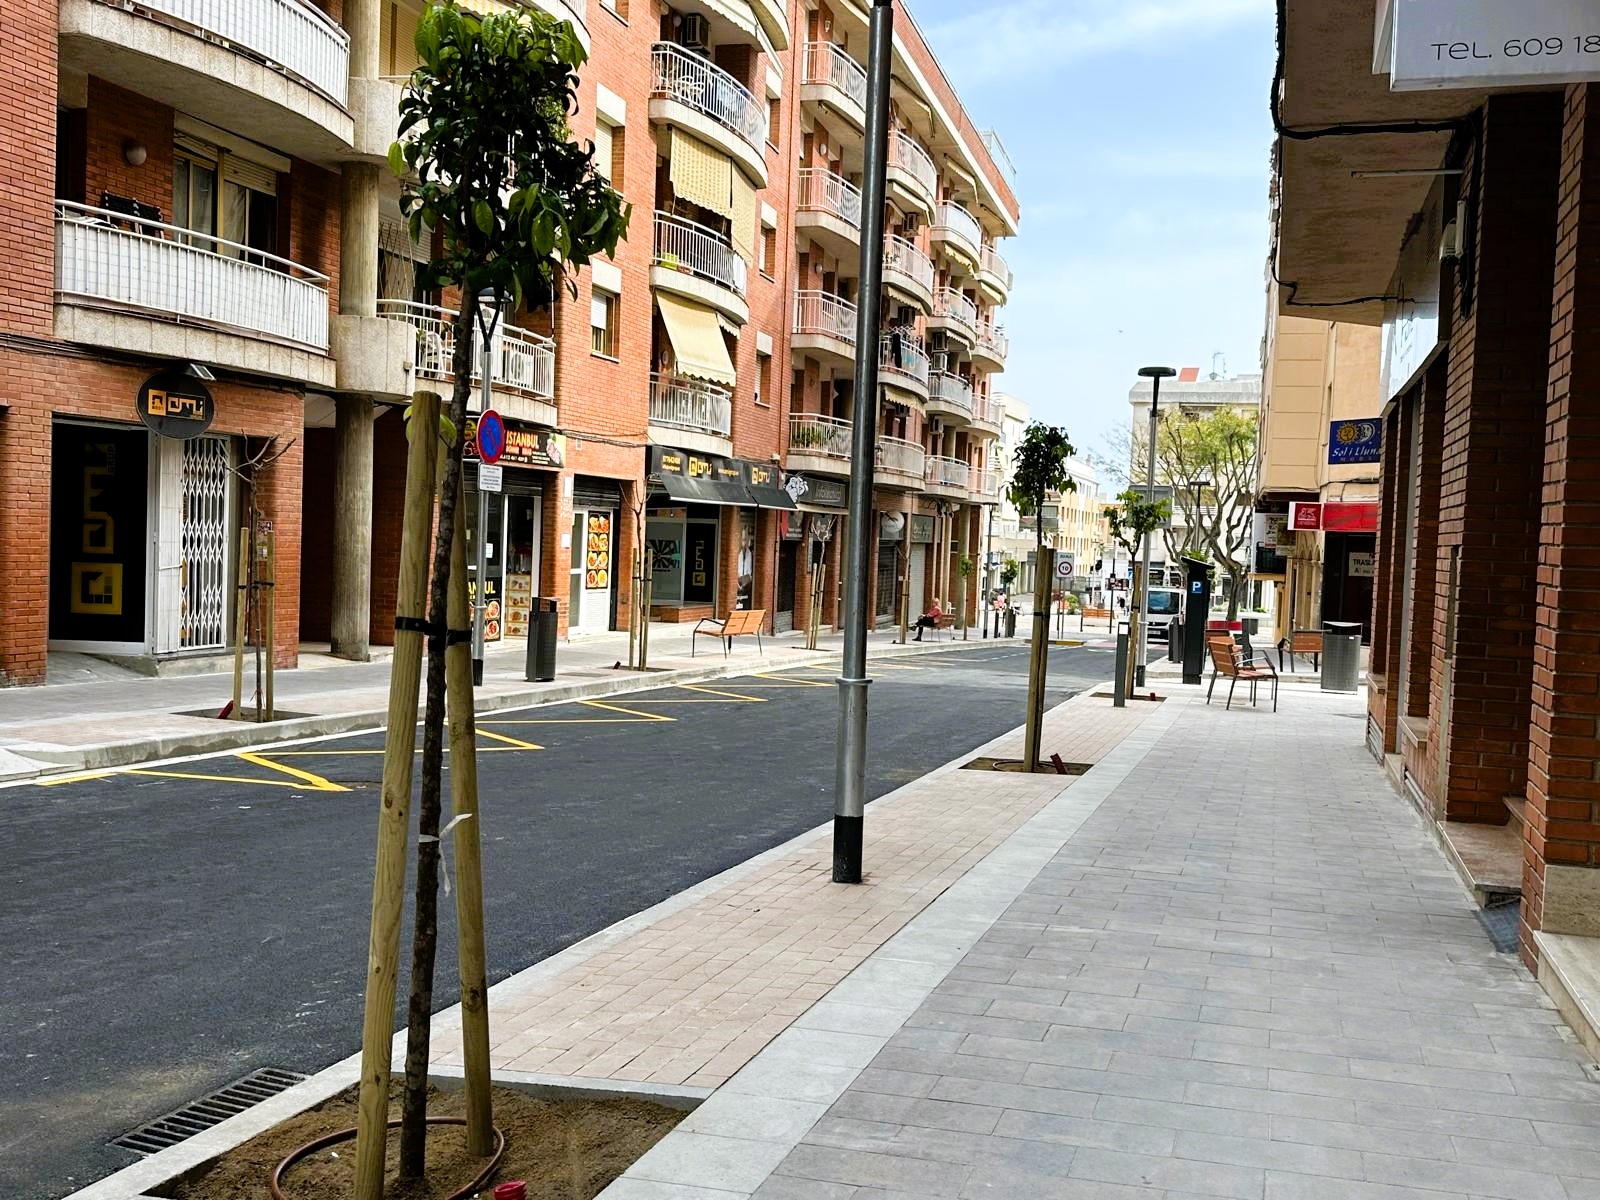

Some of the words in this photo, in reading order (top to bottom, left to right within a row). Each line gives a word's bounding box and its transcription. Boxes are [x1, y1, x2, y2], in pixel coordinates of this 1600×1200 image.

[1504, 37, 1563, 57] 609
[506, 430, 540, 450] ISTANBUL
[1332, 446, 1348, 457] Sol
[1192, 581, 1202, 592] P
